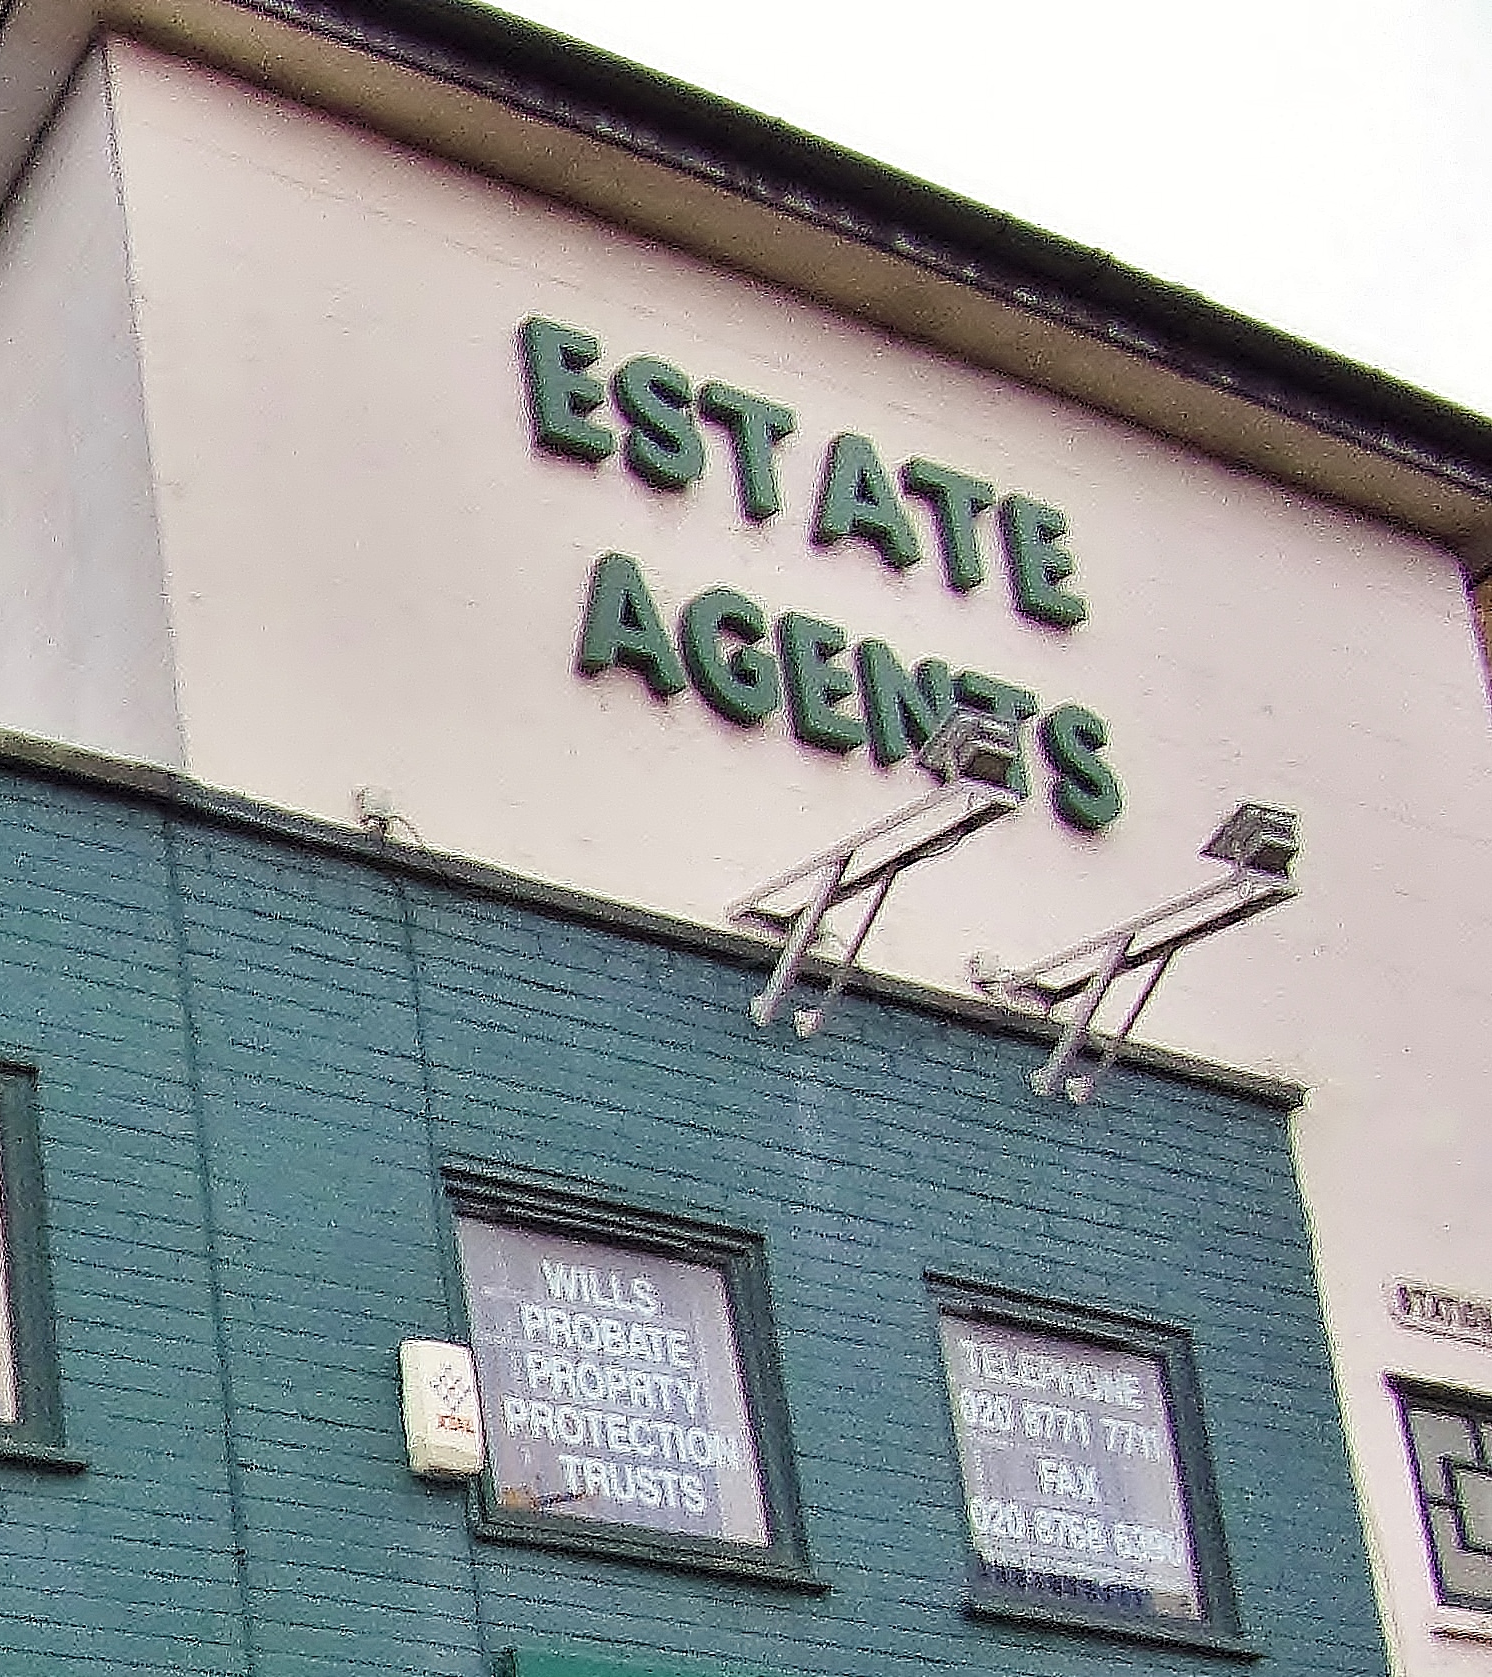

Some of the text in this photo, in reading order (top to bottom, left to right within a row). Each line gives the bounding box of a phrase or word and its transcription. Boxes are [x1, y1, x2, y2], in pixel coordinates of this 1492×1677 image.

[518, 316, 1089, 629] ESTATE
[576, 552, 1123, 831] AGENTS
[541, 1259, 659, 1319] WILLS
[521, 1304, 693, 1369] PROBATE
[525, 1352, 699, 1416] PROPRTY
[959, 1337, 1145, 1410] TELEPHONE
[503, 1396, 740, 1470] PROTECTION
[960, 1389, 1014, 1434] 020
[1022, 1400, 1091, 1448] 8771
[558, 1453, 707, 1514] TRUSTS
[1037, 1458, 1104, 1505] FAX
[969, 1497, 1025, 1540] 020
